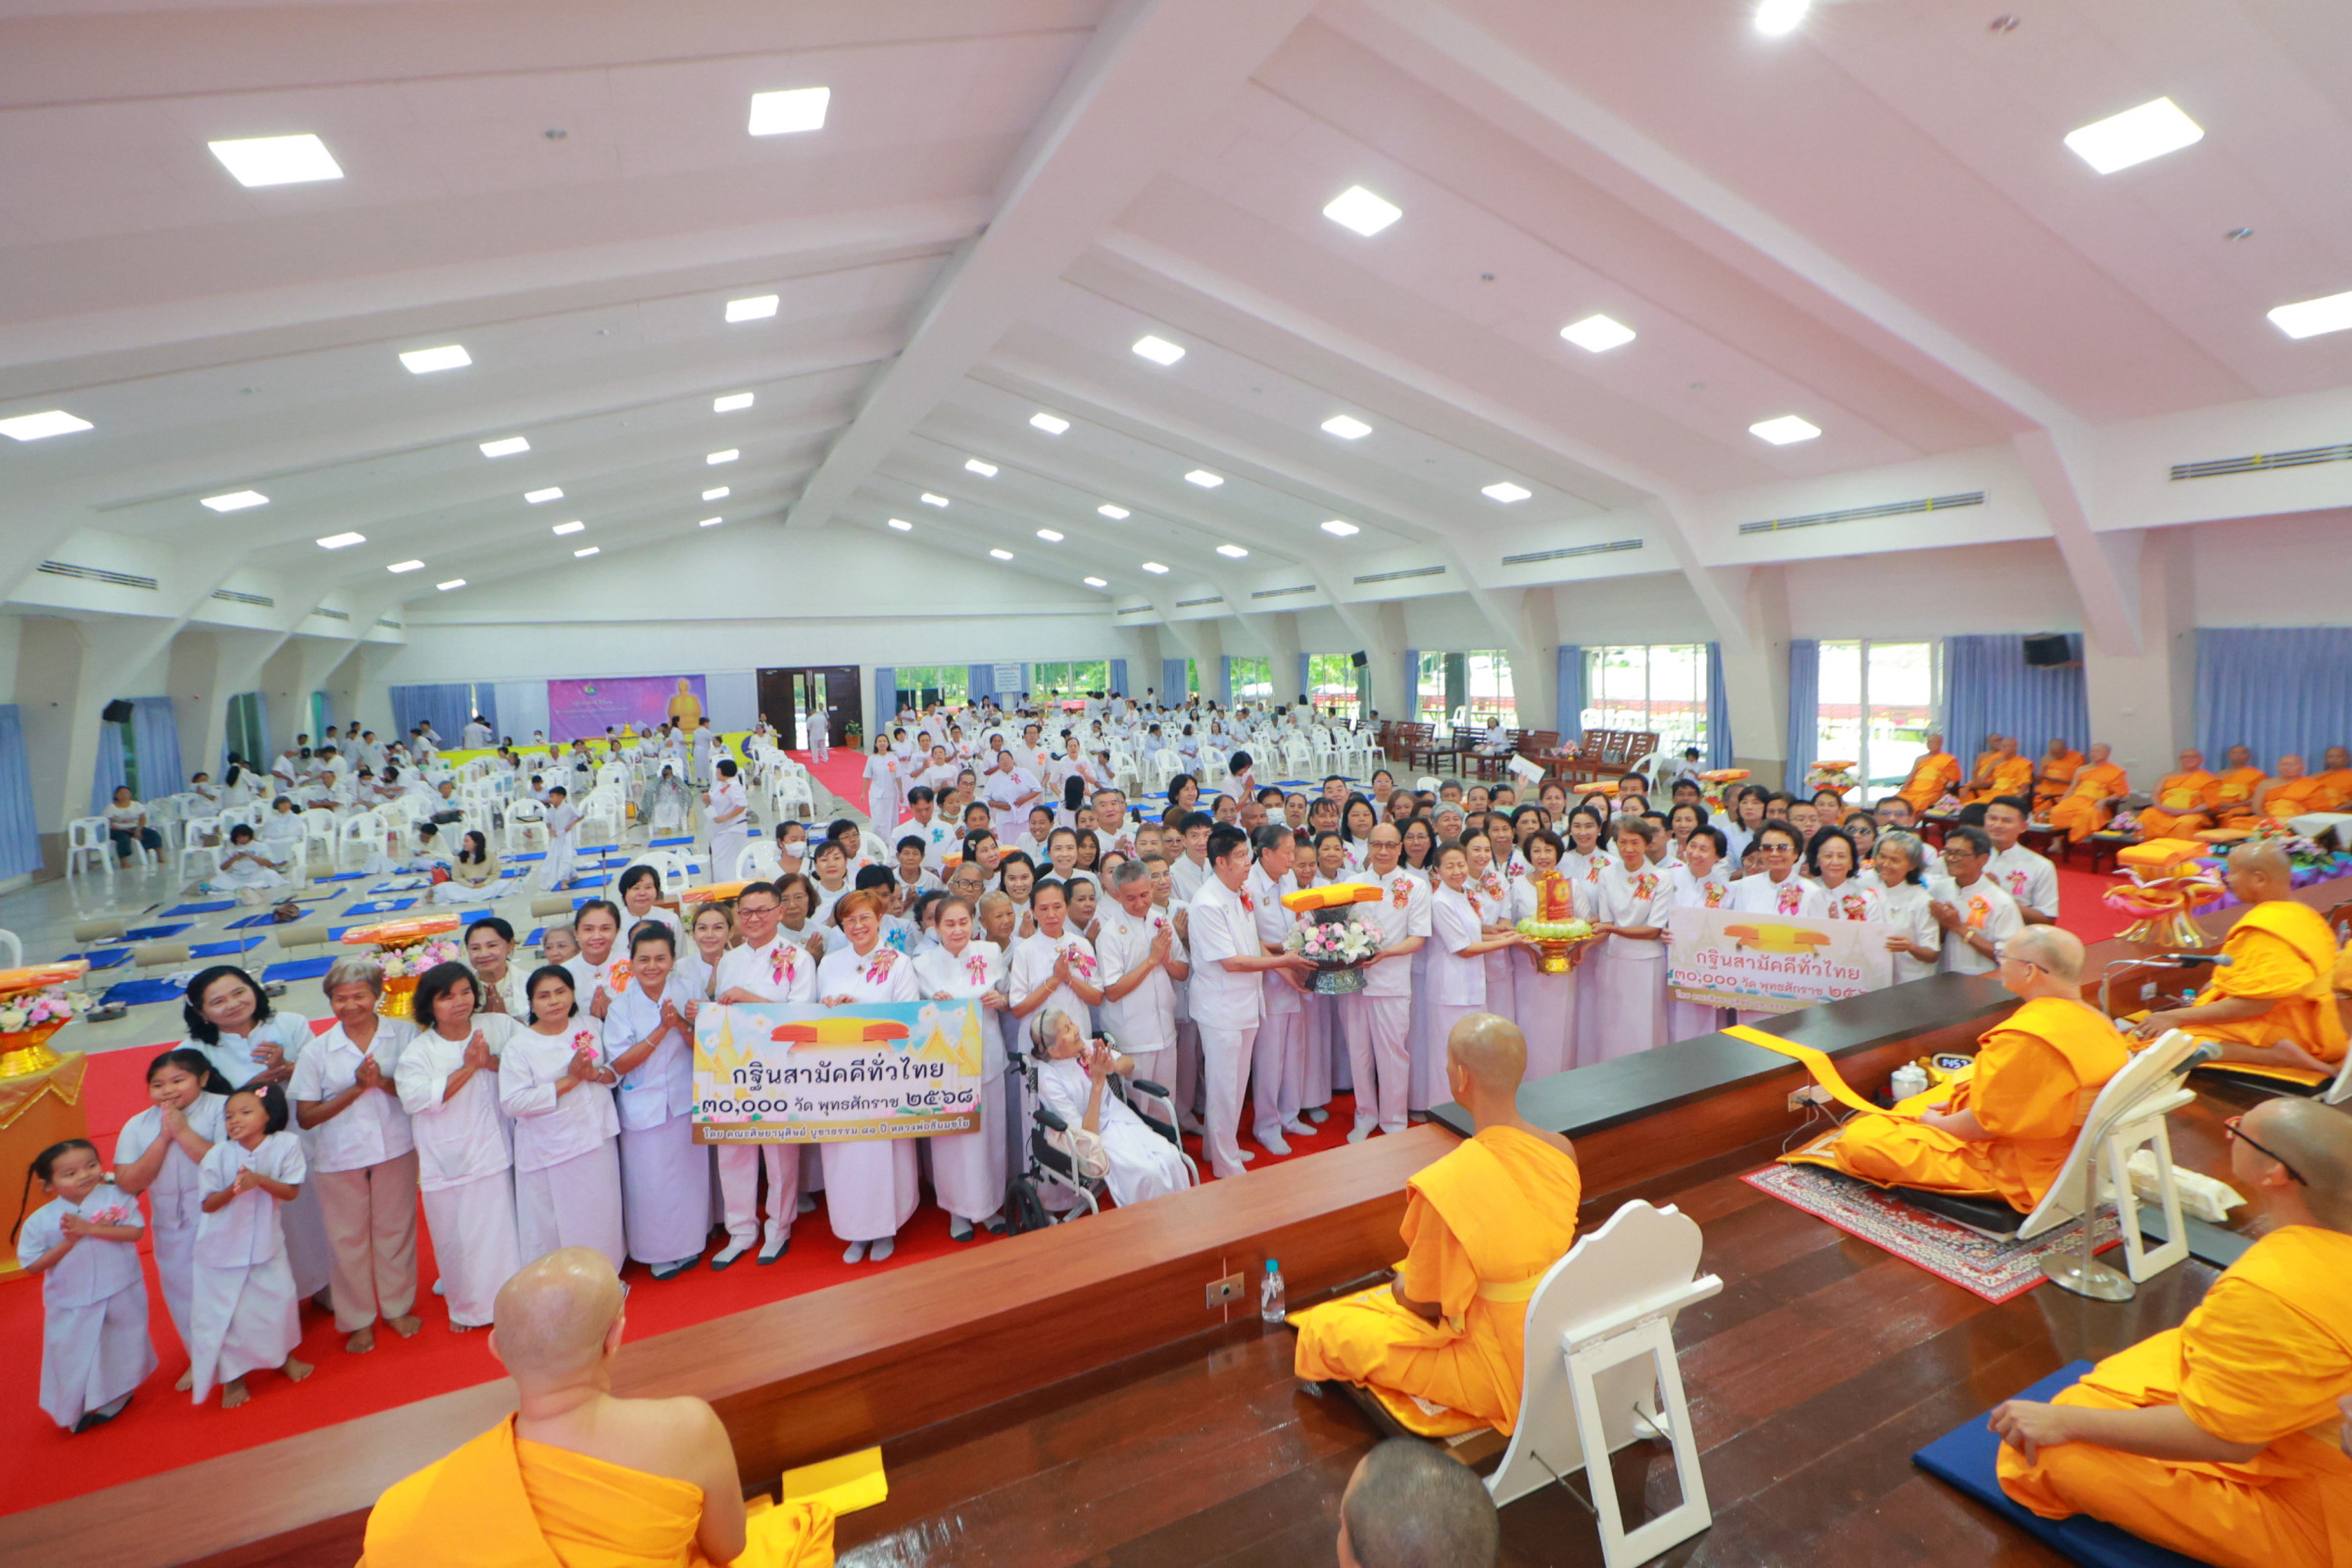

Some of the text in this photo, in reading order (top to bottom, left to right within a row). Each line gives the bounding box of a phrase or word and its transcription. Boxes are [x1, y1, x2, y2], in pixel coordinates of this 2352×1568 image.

[1696, 949, 1861, 980] กฐินสามัคคีทั่วไทย
[1741, 977, 1756, 989] วัด
[732, 1053, 945, 1092] กฐินสามัคคีทั่วไทย
[702, 1087, 973, 1116] ๓๐,๐๐๐ วัด พุทธศักราช ๒๕๖๘
[704, 1126, 724, 1139] โดย
